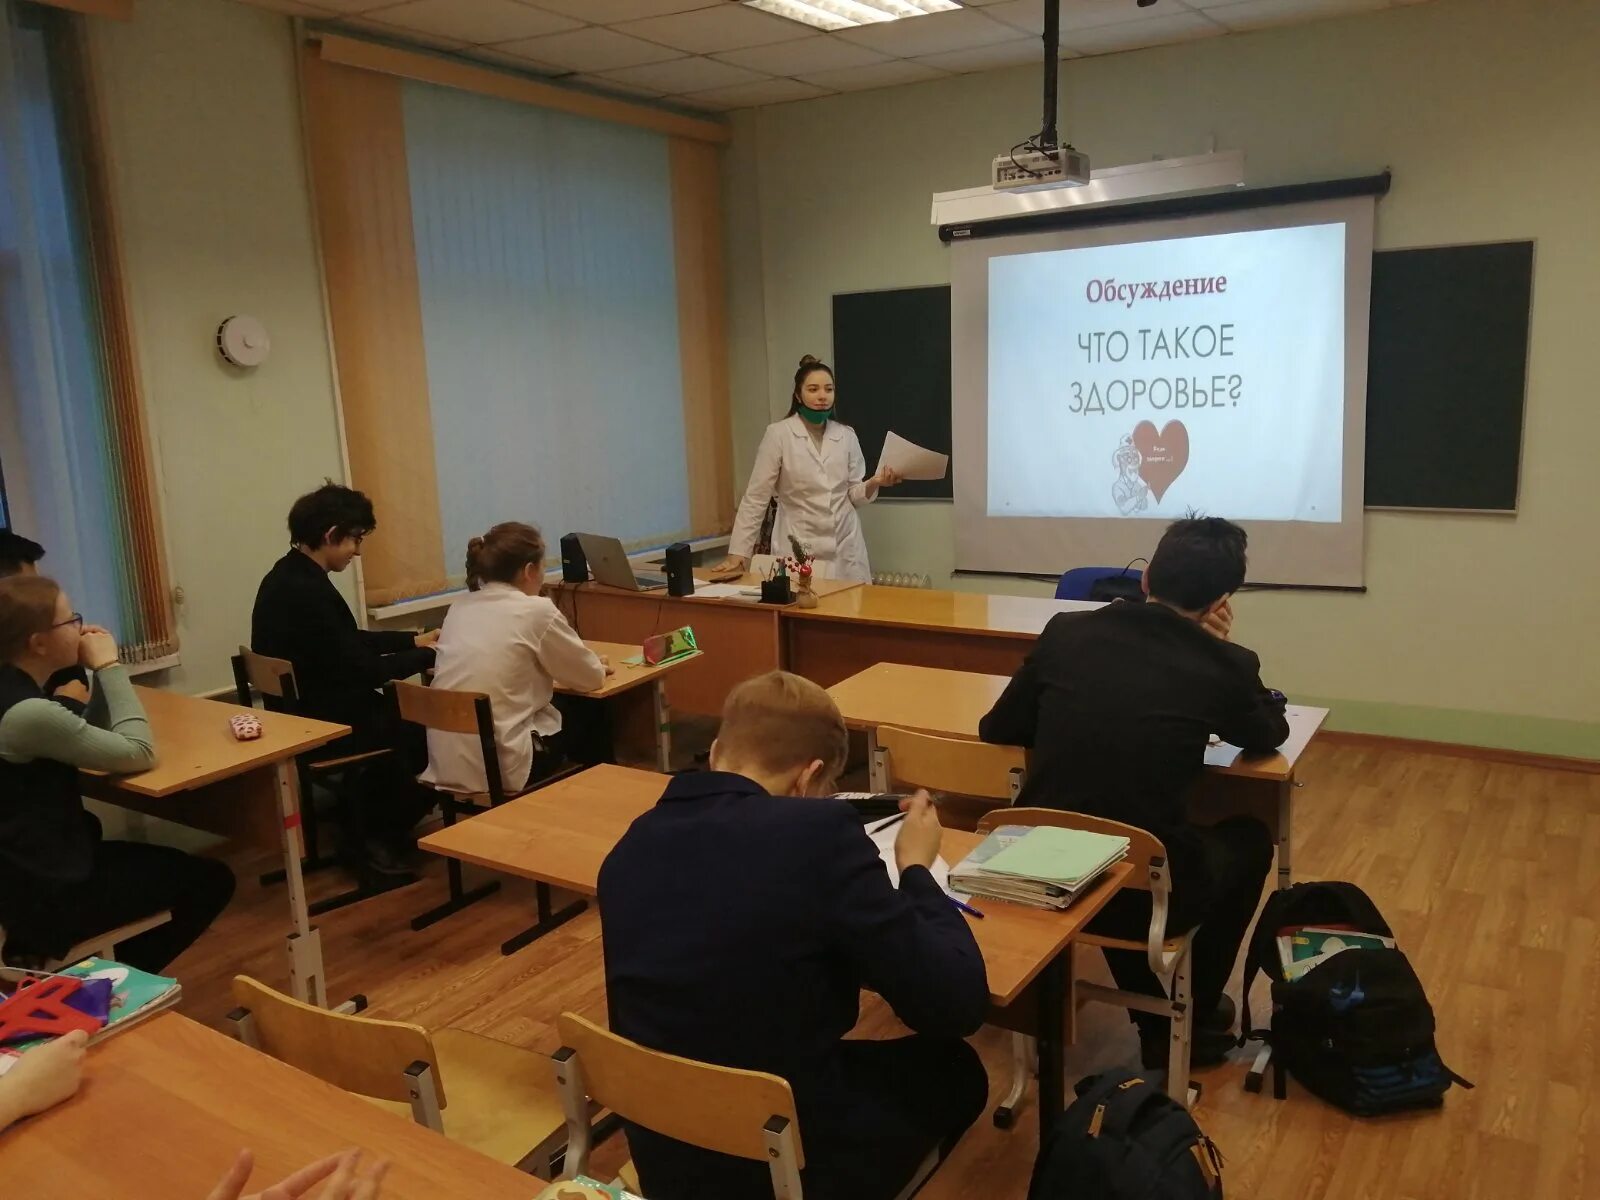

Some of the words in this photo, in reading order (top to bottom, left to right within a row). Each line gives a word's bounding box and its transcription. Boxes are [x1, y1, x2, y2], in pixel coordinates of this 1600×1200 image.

[1086, 275, 1227, 308] Обсуждение
[1078, 330, 1129, 363] ЧТО
[1138, 323, 1234, 361] ТАКОЕ
[1069, 374, 1242, 416] ЗДОРОВЬЕ?
